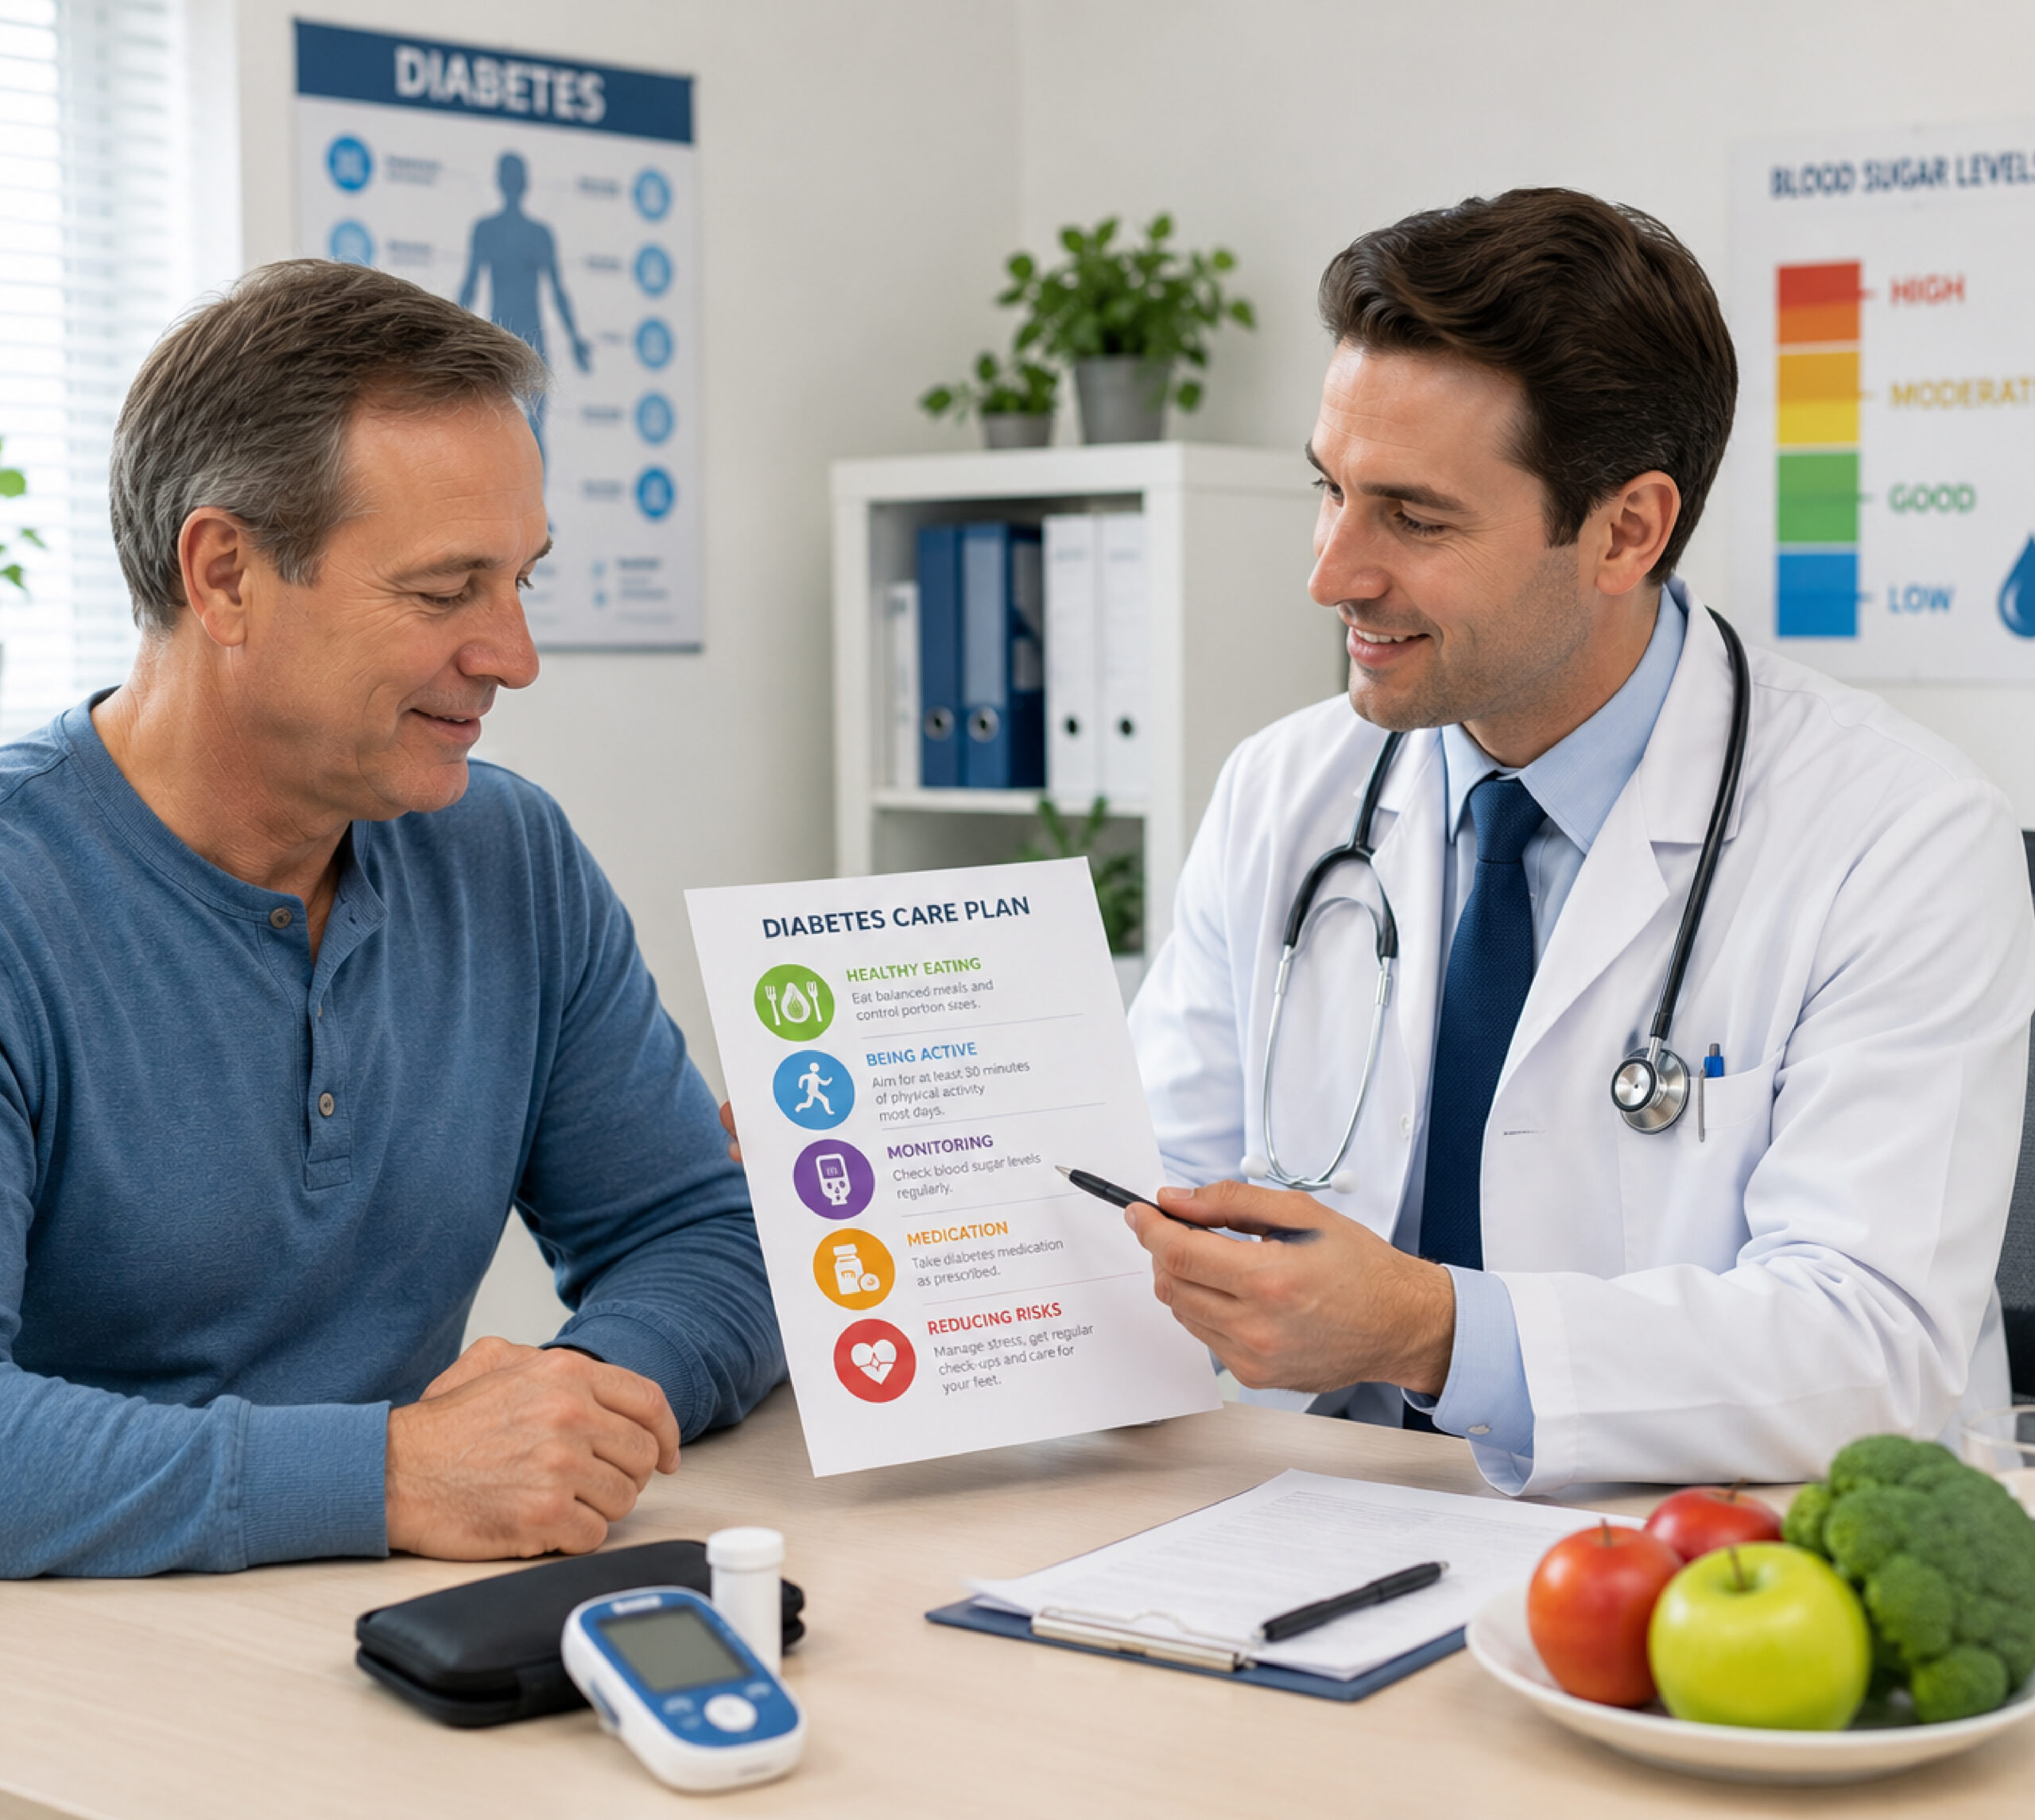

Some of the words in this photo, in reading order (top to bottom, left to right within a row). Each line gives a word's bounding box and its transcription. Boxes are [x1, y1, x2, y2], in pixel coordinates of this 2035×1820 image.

[394, 45, 606, 122] DIABETES
[1770, 161, 1856, 199] BLOOD
[1863, 153, 1948, 193] SUGAR
[1955, 148, 2035, 188] LEVEL
[1890, 274, 1966, 306] HIGH
[1890, 377, 2035, 409] MODERAT
[1889, 482, 1976, 513] GOOD
[1886, 585, 1954, 614] LOW
[762, 909, 886, 939] DIABETES
[892, 903, 959, 927] CARE
[964, 896, 1030, 920] PLAN
[846, 963, 918, 982] HEALTHY
[923, 957, 982, 975] EATING
[851, 993, 872, 1005] Eat
[875, 986, 929, 1001] balanced
[933, 982, 968, 996] meals
[971, 979, 994, 992] and
[856, 1006, 899, 1021] control
[866, 1049, 916, 1067] BEING
[921, 1042, 978, 1061] ACTIVE
[872, 1077, 897, 1089] Aim
[898, 1074, 916, 1086] for
[919, 1072, 932, 1082] at
[933, 1069, 962, 1081] least
[983, 1061, 1030, 1075] minutes
[875, 1093, 888, 1105] of
[943, 1083, 985, 1098] activity
[879, 1109, 910, 1121] most
[913, 1106, 945, 1119] days.
[886, 1134, 994, 1159] MONITORING
[893, 1168, 932, 1181] Check
[933, 1161, 969, 1176] blood
[971, 1158, 1005, 1173] sugar
[1007, 1153, 1041, 1168] levels
[897, 1183, 953, 1200] regularly.
[906, 1221, 1009, 1247] MEDICATION
[912, 1257, 941, 1269] Take
[943, 1248, 994, 1266] diabetes
[997, 1239, 1064, 1257] medication
[917, 1276, 932, 1287] as
[927, 1310, 1013, 1335] REDUCING
[1016, 1303, 1062, 1322] RISKS
[934, 1342, 984, 1357] Manage
[1029, 1331, 1049, 1346] get
[1051, 1323, 1093, 1342] regular
[1004, 1351, 1027, 1365] and
[1029, 1349, 1056, 1361] care
[1057, 1345, 1075, 1357] for
[942, 1378, 970, 1396] your
[973, 1374, 1002, 1388] feet.
